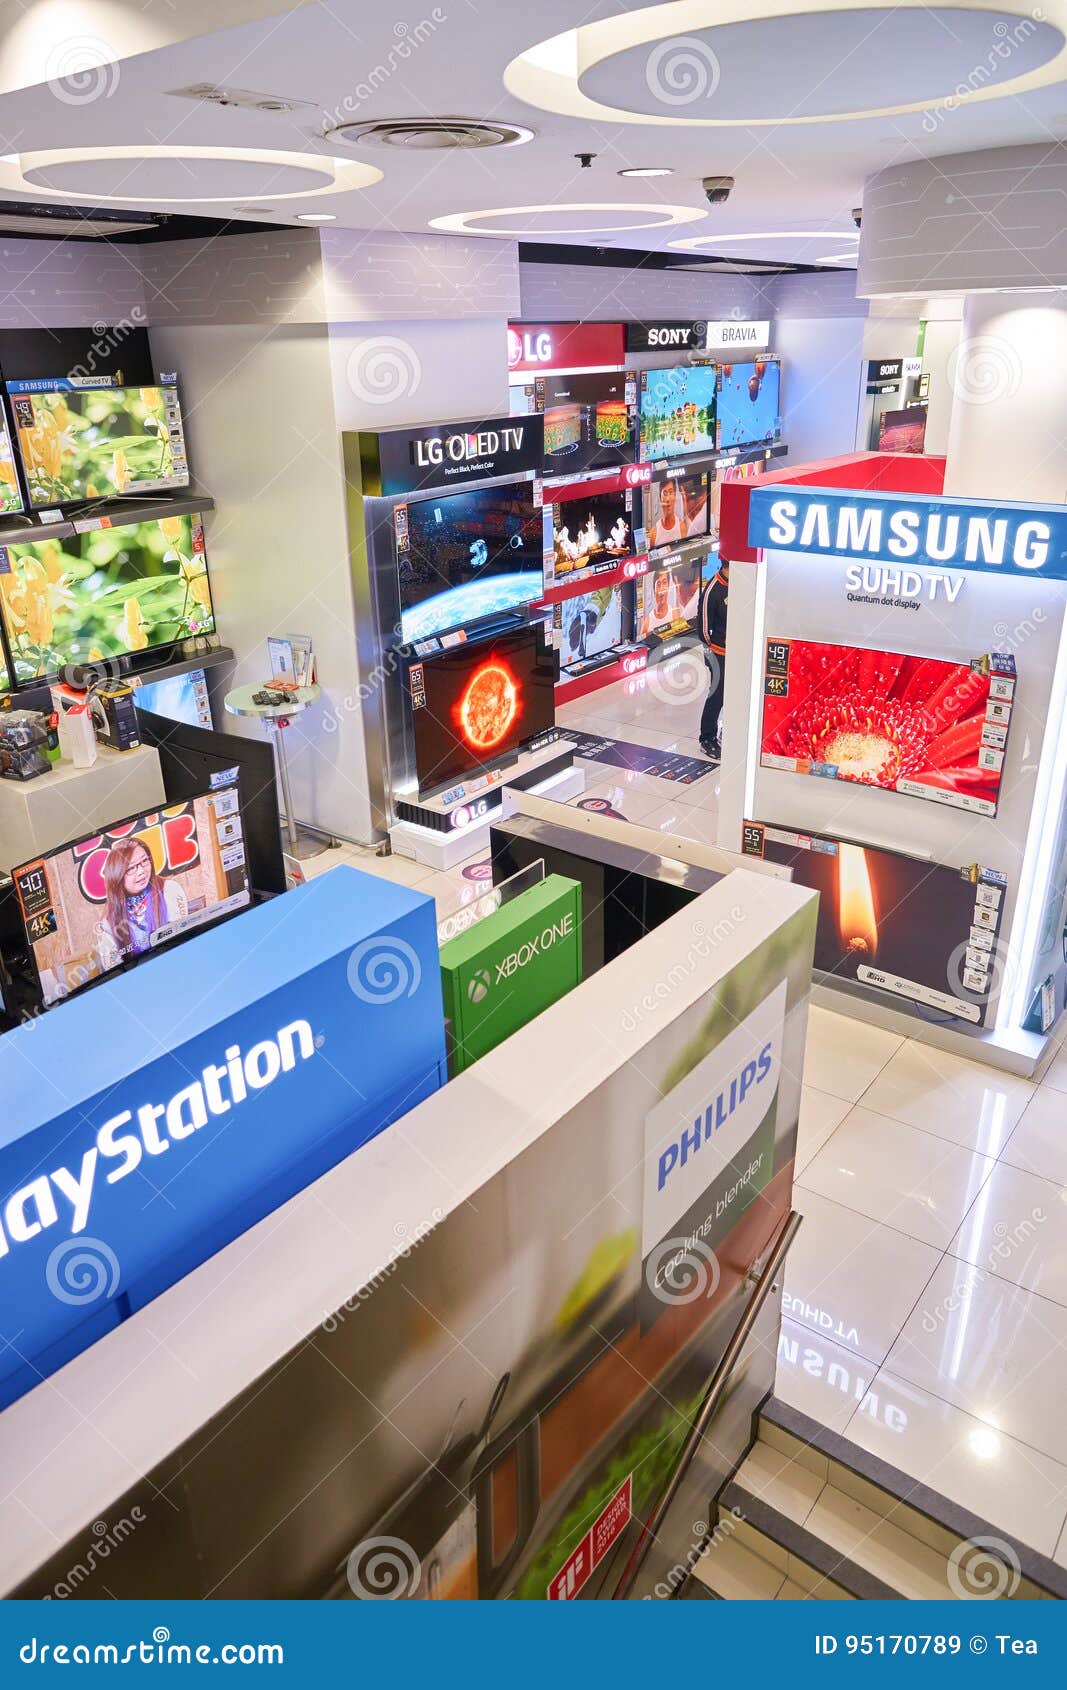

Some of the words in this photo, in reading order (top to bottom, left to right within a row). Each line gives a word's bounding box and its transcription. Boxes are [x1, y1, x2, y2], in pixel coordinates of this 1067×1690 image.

[648, 328, 691, 345] SONY
[722, 328, 757, 342] BRAVIA
[523, 333, 552, 362] LG
[880, 365, 899, 376] SONY
[19, 380, 59, 391] SAMSUNG
[81, 377, 101, 385] Curved
[101, 376, 109, 384] TV
[417, 438, 443, 467] LG
[448, 431, 499, 461] OLED
[502, 427, 524, 452] TV
[640, 469, 651, 481] LG
[768, 500, 1051, 570] SAMSUNG
[636, 560, 648, 572] LG
[845, 565, 923, 598] SUHD
[925, 573, 966, 603] TV
[847, 592, 880, 604] Quantum
[881, 597, 893, 606] dot
[894, 598, 921, 611] display
[198, 621, 210, 629] LG
[636, 656, 646, 667] LG
[768, 679, 784, 690] 4K
[216, 773, 233, 783] NEW
[471, 800, 487, 818] LG
[31, 913, 51, 932] 4K
[36, 927, 49, 937] UHD
[495, 935, 540, 985] XBOX
[540, 912, 574, 950] ONE
[657, 1042, 772, 1192] PHILIPS
[0, 1019, 315, 1258] ayStation
[654, 1213, 713, 1290] Cooking
[715, 1152, 764, 1220] blender
[597, 1493, 626, 1537] DESIGN
[597, 1501, 627, 1546] AWARD
[597, 1526, 616, 1554] 2016
